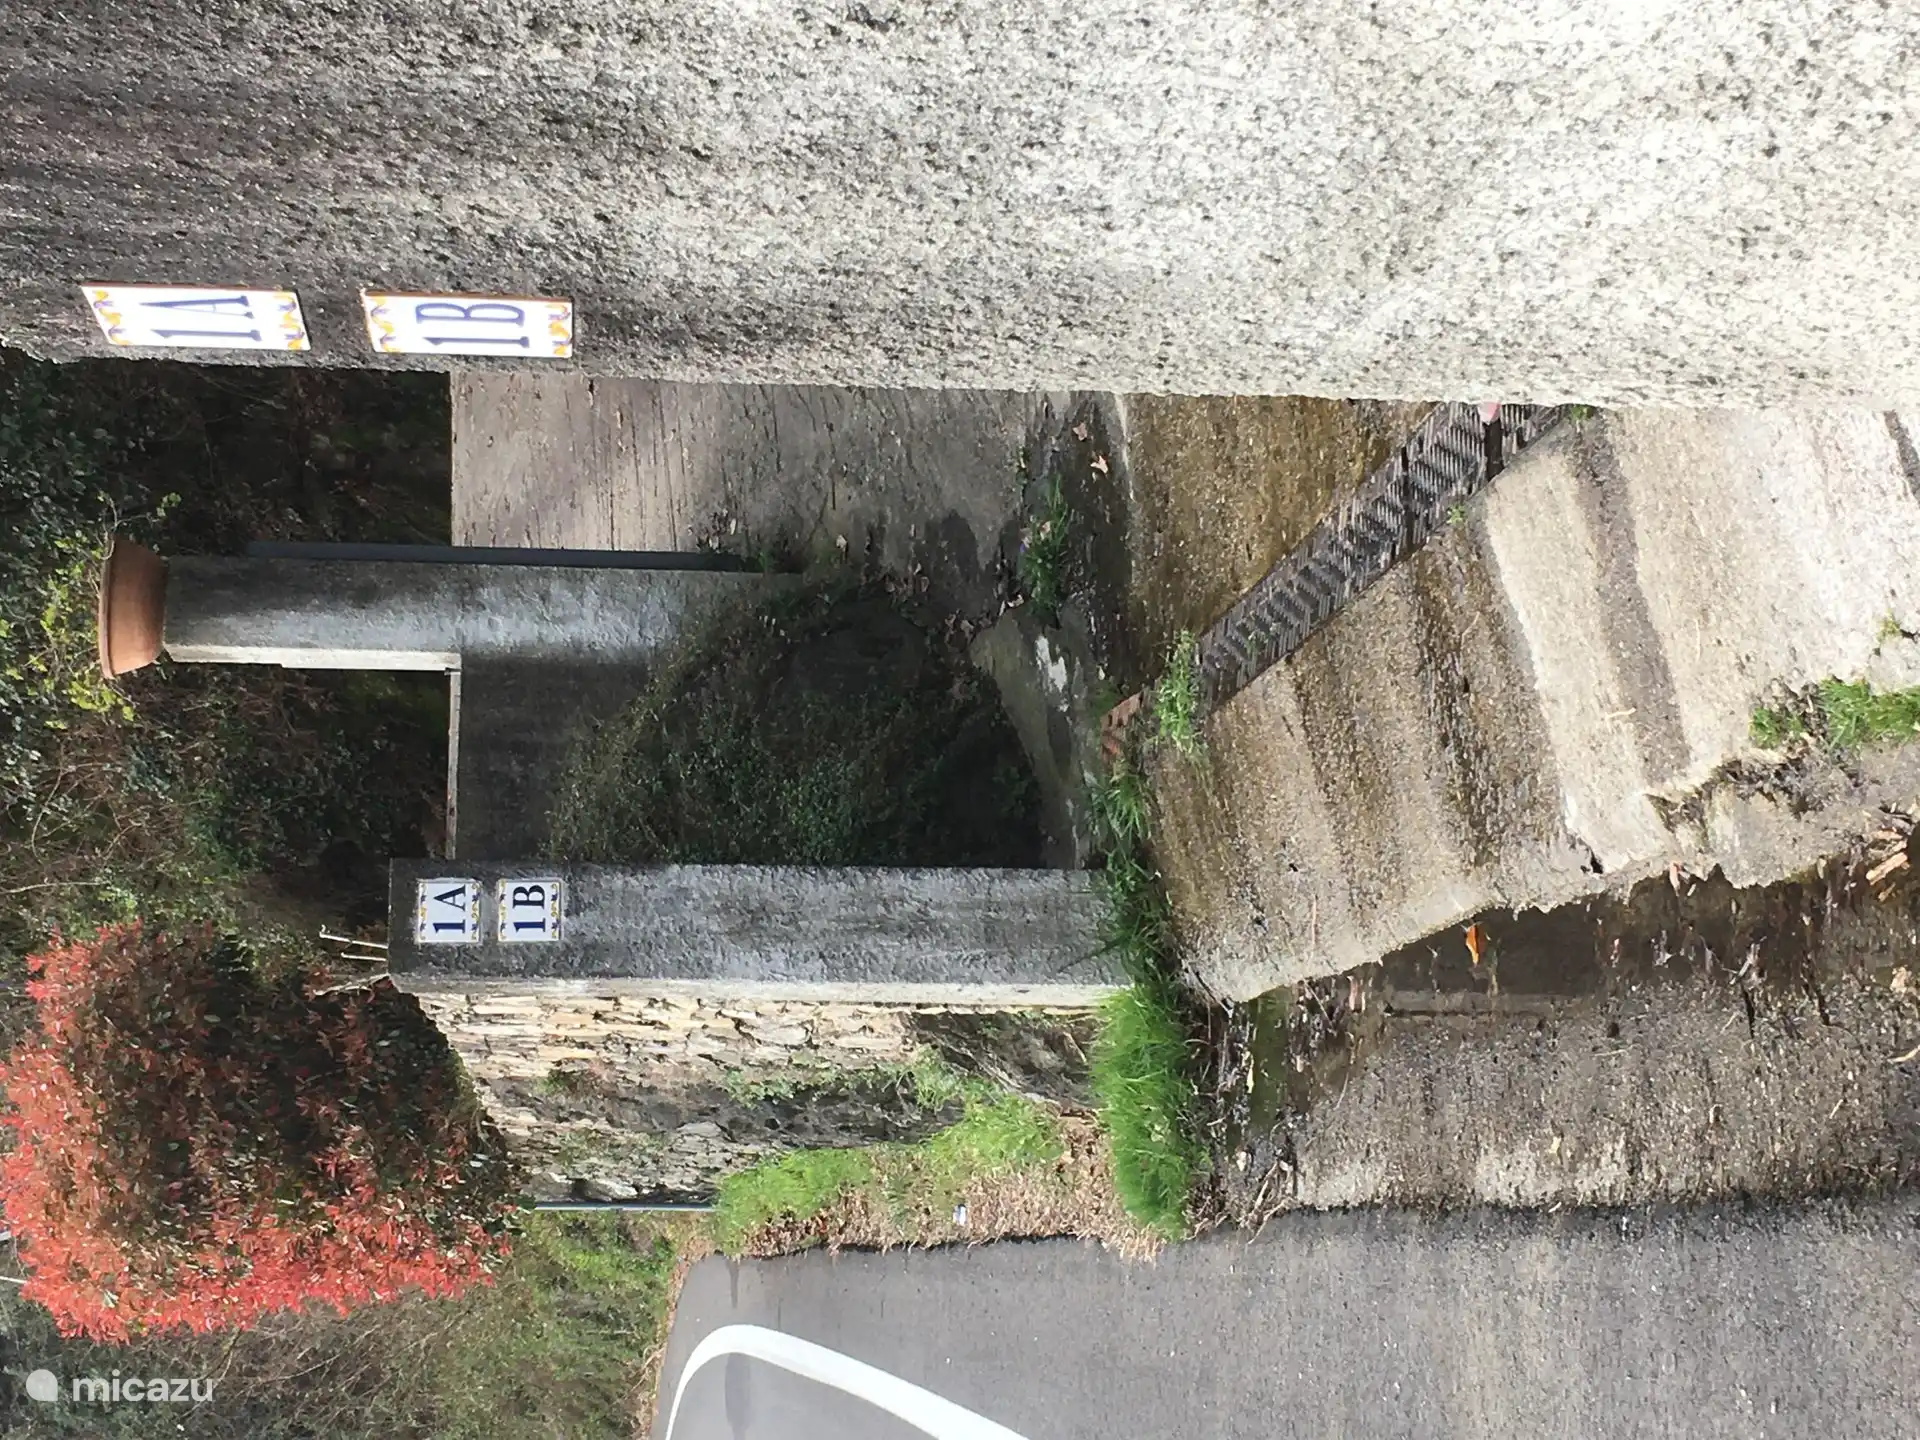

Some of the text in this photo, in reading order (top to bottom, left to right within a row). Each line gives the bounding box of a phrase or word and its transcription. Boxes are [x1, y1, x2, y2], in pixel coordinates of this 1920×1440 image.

[138, 295, 262, 341] 1A
[415, 302, 530, 348] 1B
[432, 884, 467, 934] 1A
[512, 884, 546, 933] 1B
